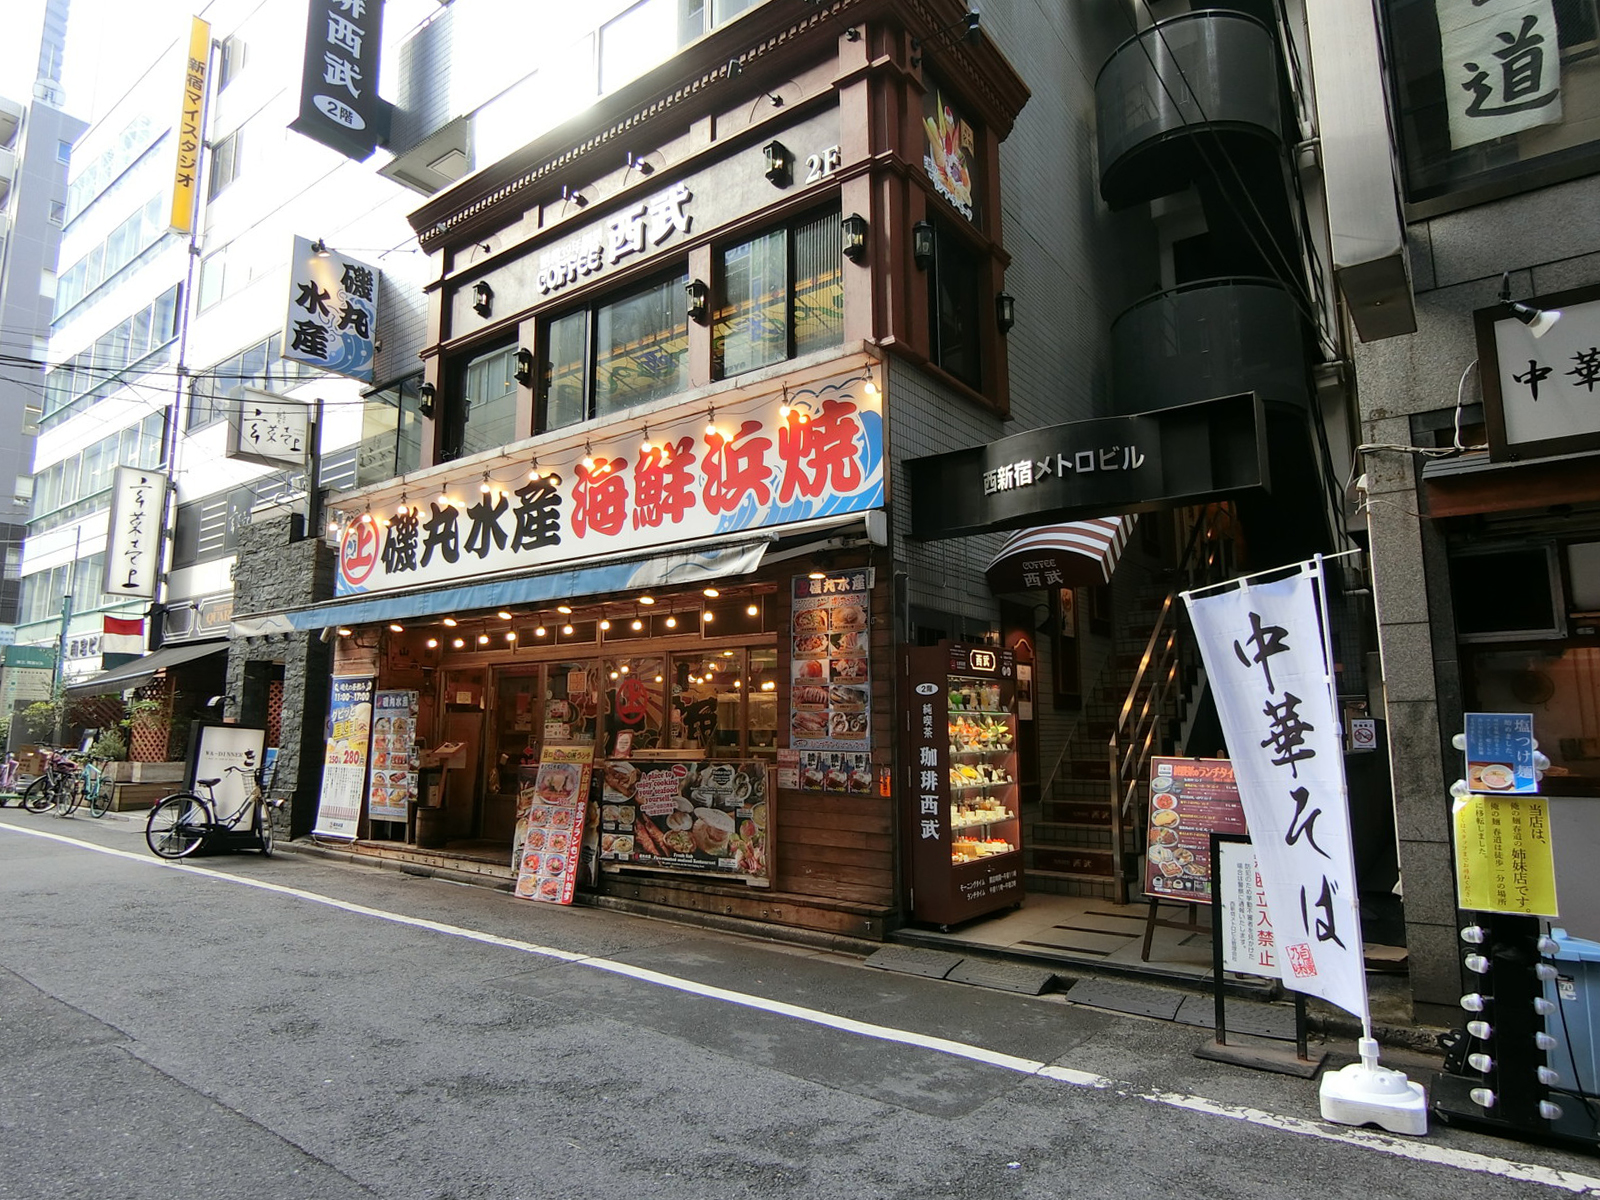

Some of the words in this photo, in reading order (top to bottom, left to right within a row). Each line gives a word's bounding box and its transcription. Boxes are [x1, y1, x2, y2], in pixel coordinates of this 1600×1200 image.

[1461, 0, 1560, 118] 道
[177, 57, 206, 188] 新宿マイスタジオ
[326, 101, 353, 125] 2階
[805, 145, 841, 184] 2F
[537, 246, 603, 295] COFFEE
[607, 183, 693, 265] 西武
[290, 280, 331, 361] 水産
[341, 262, 374, 339] 磯丸
[382, 472, 563, 574] 磯丸水産
[571, 399, 864, 539] 海鮮浜焼
[983, 445, 1146, 496] 西新宿メトロビル
[1022, 558, 1057, 570] COFFEE
[1023, 569, 1064, 588] 西武
[975, 654, 991, 667] 西武
[1514, 718, 1533, 780] 塩つけ麺
[920, 746, 941, 841] 珈琲西武
[1234, 611, 1347, 951] 中華そば
[1529, 803, 1546, 845] 当店は、
[1561, 982, 1574, 991] 70
